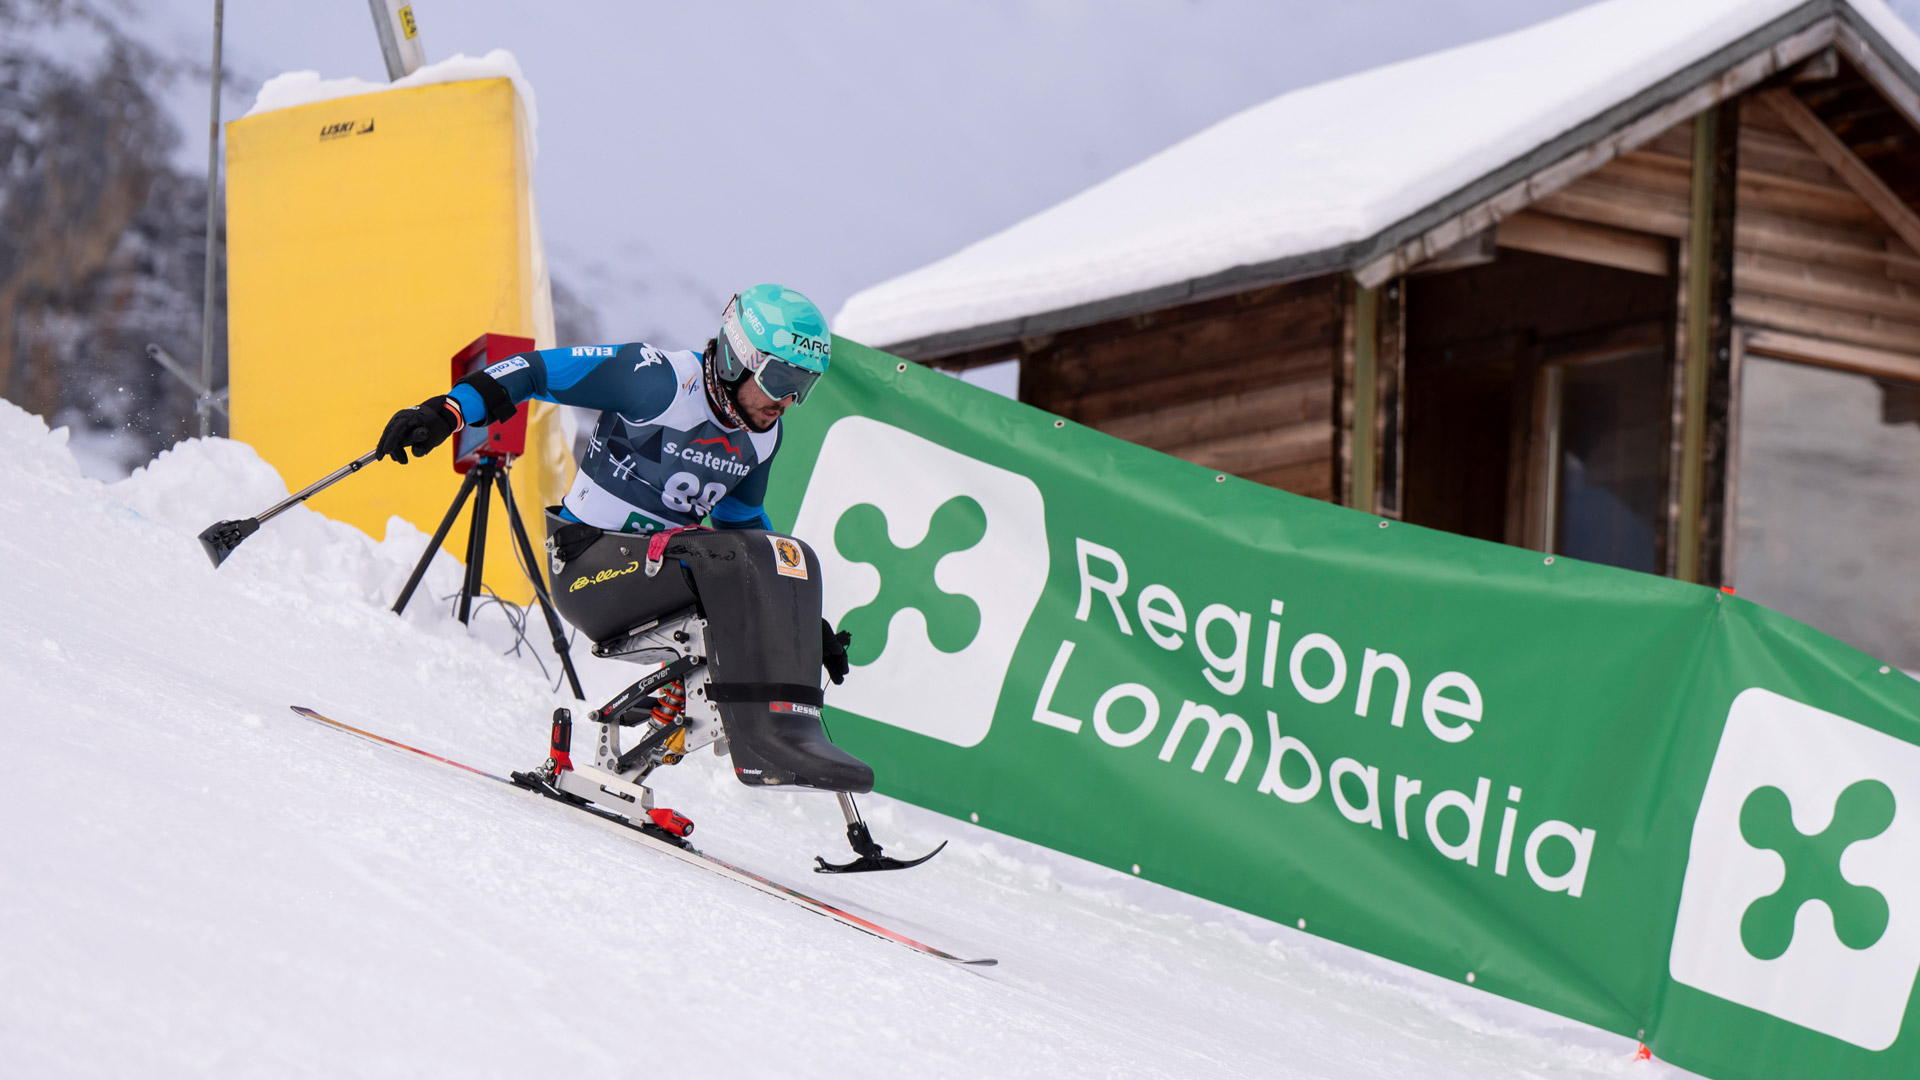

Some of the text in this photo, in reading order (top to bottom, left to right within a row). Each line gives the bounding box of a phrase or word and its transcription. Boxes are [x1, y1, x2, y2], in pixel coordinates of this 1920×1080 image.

[320, 121, 355, 136] LISKI
[727, 320, 747, 354] SHRED
[744, 307, 765, 336] SHRED
[663, 440, 751, 477] s.caterina
[1075, 537, 1483, 743] Regione
[612, 693, 630, 710] tessier
[742, 768, 763, 776] tessier
[1032, 640, 1596, 898] Lombardia
